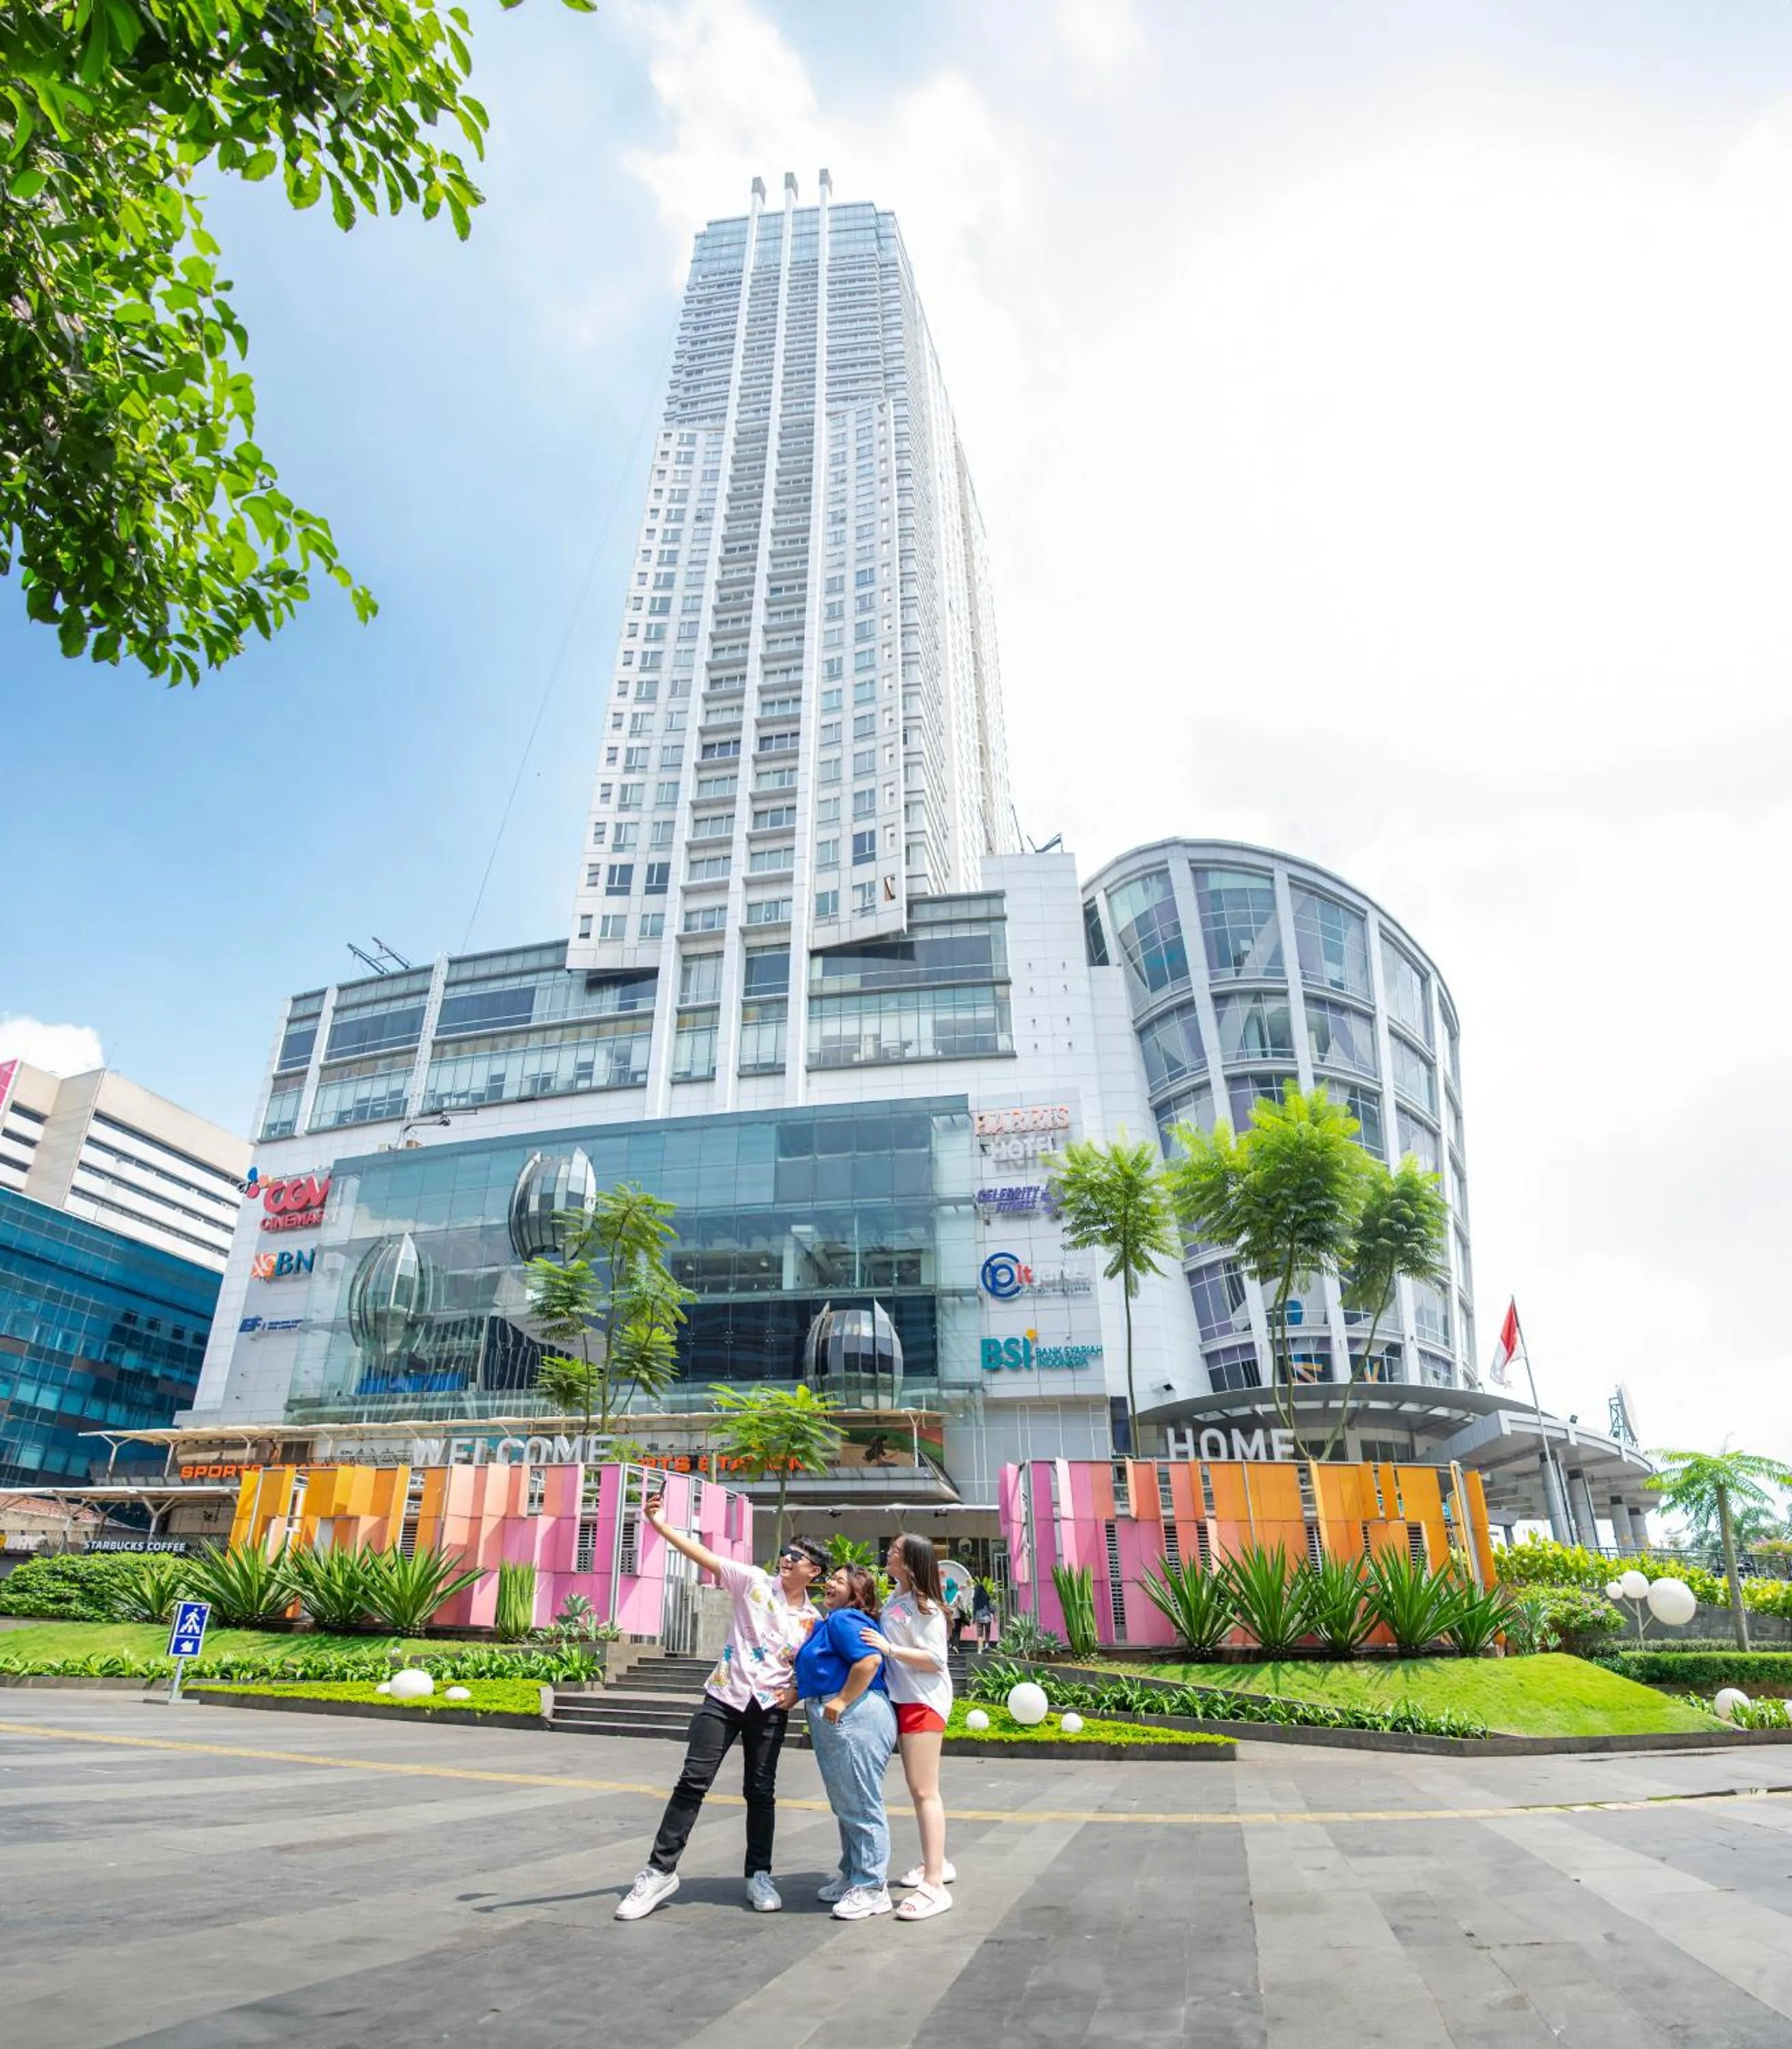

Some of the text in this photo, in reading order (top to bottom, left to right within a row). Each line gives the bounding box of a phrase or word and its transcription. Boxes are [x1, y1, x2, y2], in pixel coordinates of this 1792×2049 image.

[264, 1175, 331, 1213] CGV
[981, 1336, 1033, 1371] BSI
[1035, 1345, 1103, 1358] BANK SYARIAH
[1166, 1427, 1295, 1461] HOME
[83, 1540, 186, 1552] STARBUCKS COFFEE
